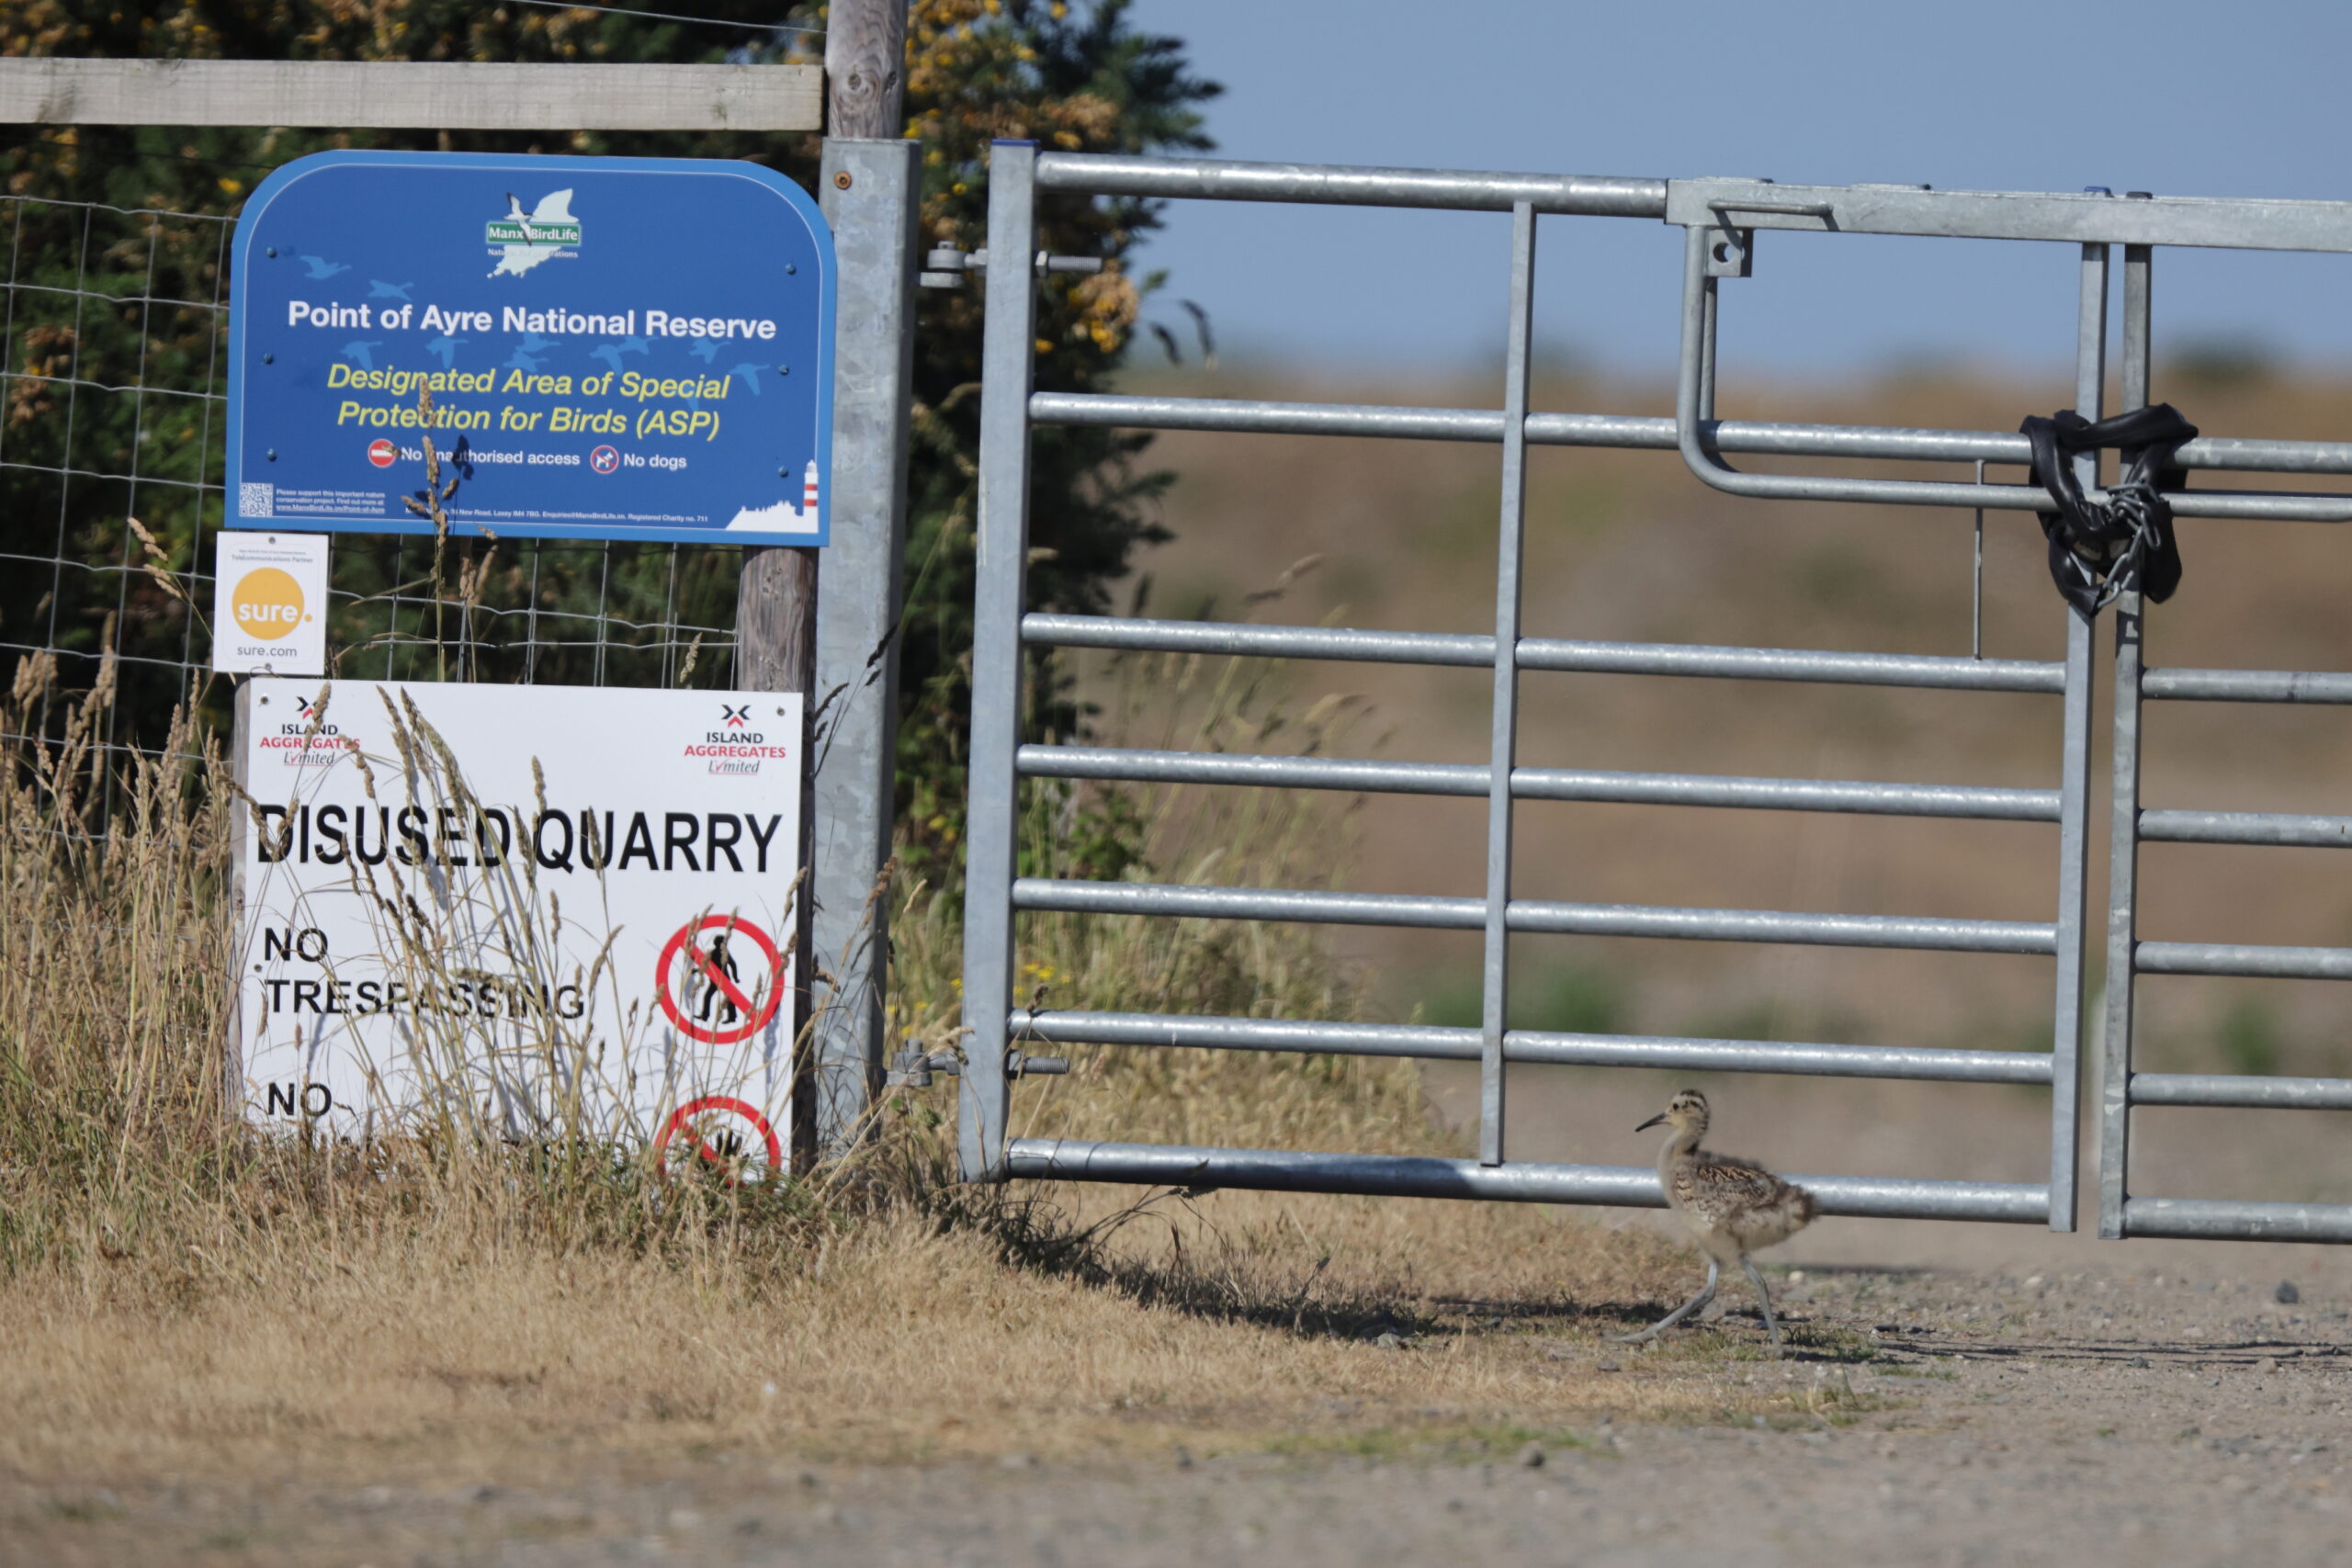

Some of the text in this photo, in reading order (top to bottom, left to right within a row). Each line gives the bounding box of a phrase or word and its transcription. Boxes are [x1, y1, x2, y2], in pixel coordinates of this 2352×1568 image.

[489, 226, 579, 241] Manx BirdLife
[288, 300, 776, 339] Point of Ayre National Reserve
[327, 363, 731, 402] Designated Area of Special
[337, 400, 720, 441] Protection for Birds (ASP)
[401, 446, 581, 466] No nathorised access
[623, 453, 687, 471] No dogs
[237, 646, 299, 658] sure.com
[259, 737, 361, 750] AGGRGATS
[706, 732, 764, 744] ISLAND
[684, 745, 786, 759] AGGREGATES
[707, 759, 761, 773] Limited
[257, 804, 784, 874] DISUSED QUARRY
[264, 927, 329, 963] NO
[266, 1081, 333, 1117] NO
